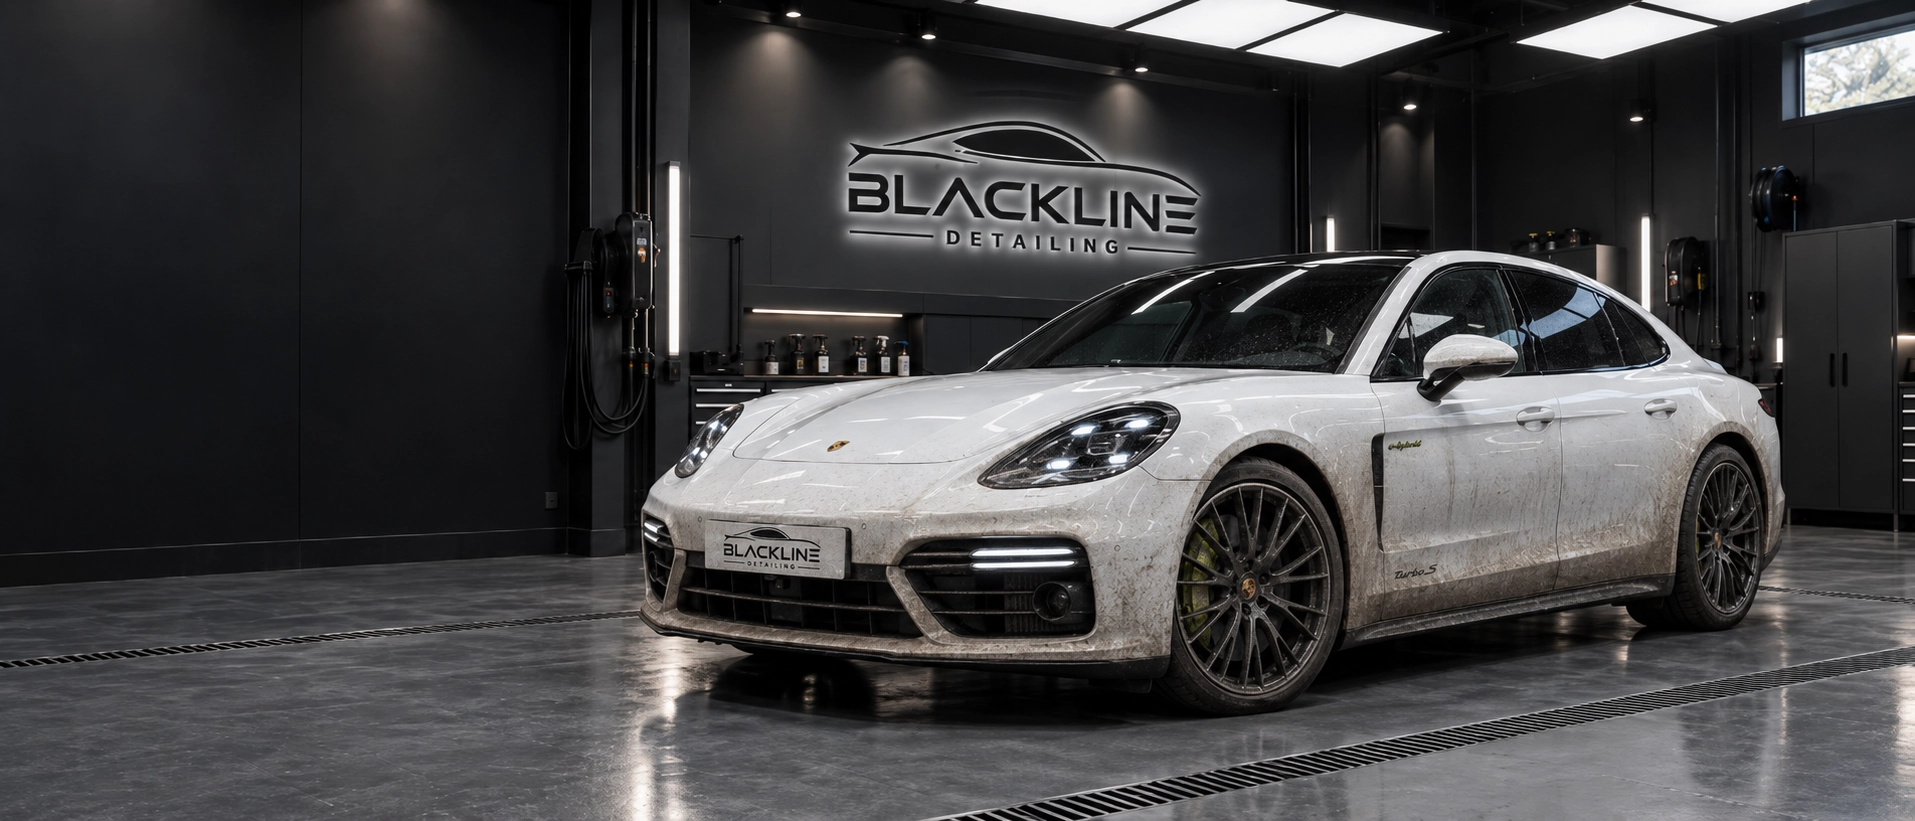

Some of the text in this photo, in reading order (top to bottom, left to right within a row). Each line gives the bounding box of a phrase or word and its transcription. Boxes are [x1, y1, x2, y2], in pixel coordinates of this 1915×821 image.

[848, 172, 1198, 235] BLACKLINE
[946, 229, 1119, 254] DETAILING
[723, 543, 820, 562] BLACKLINE
[747, 561, 795, 570] DETAILING
[1424, 563, 1437, 575] S
